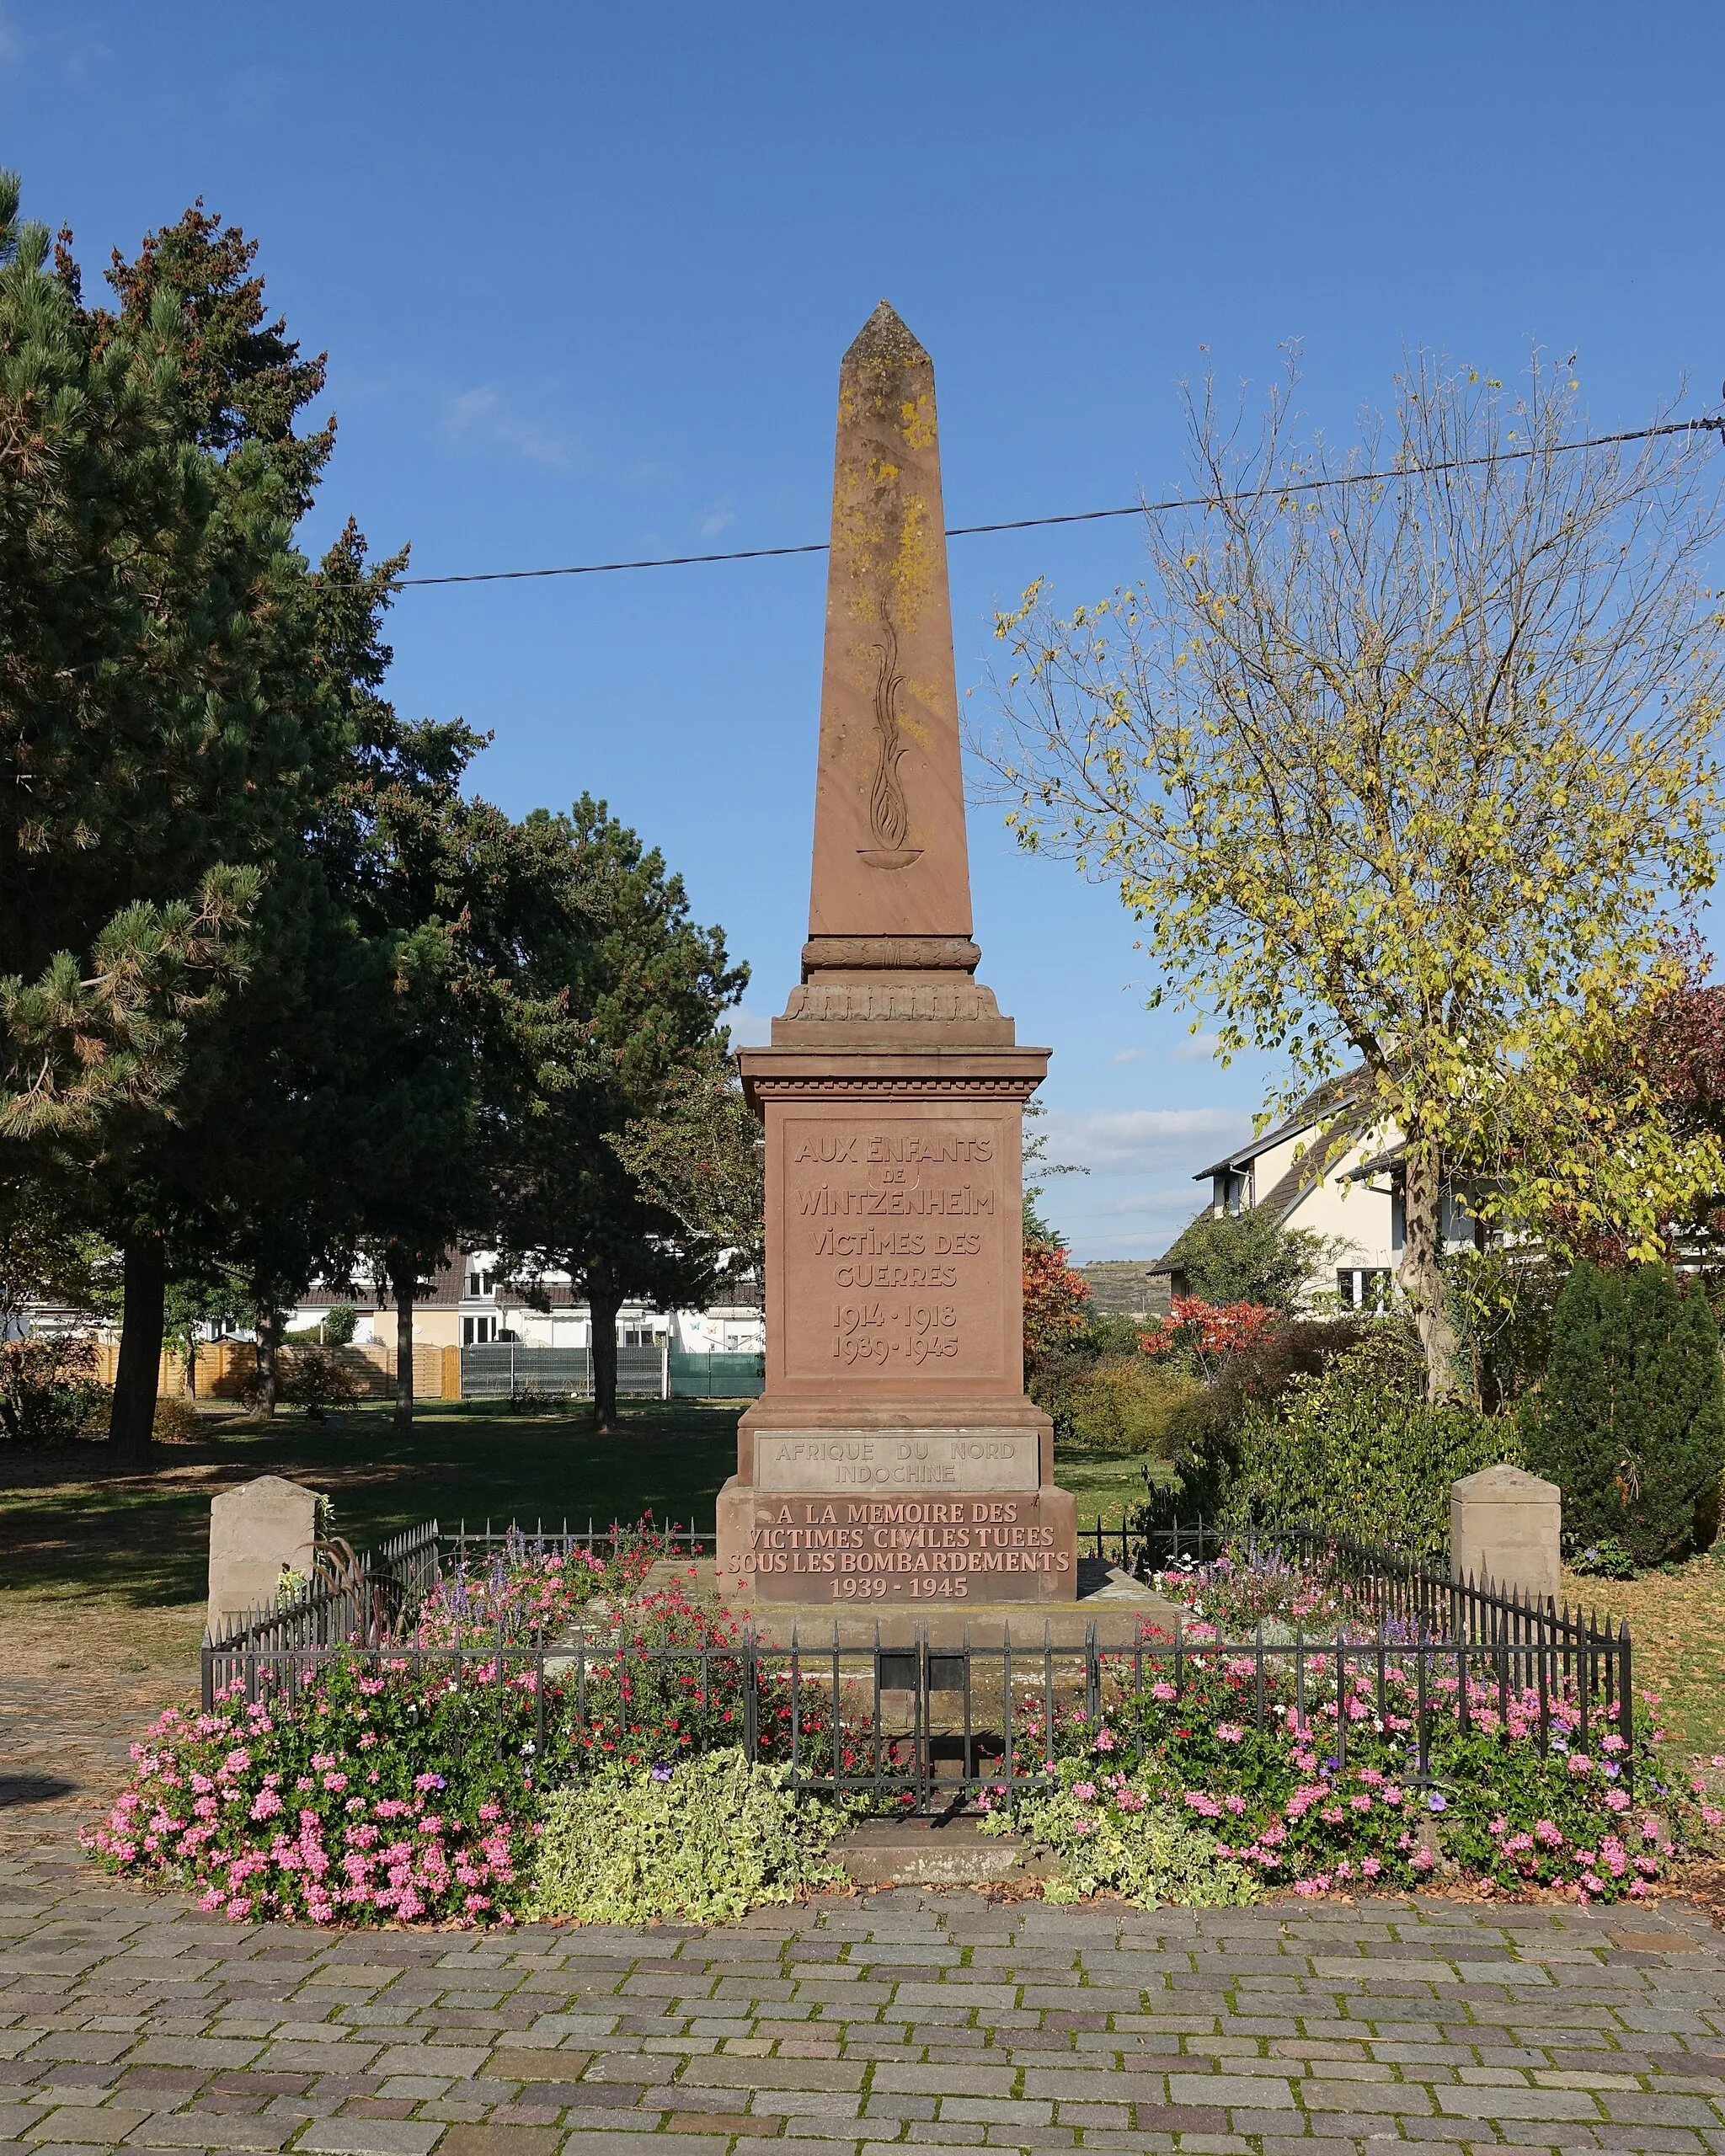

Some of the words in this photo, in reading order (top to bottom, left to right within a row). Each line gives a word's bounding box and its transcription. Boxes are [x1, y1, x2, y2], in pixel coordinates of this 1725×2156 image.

[795, 1137, 857, 1162] AUX
[866, 1136, 993, 1162] ENFANTS
[883, 1168, 906, 1183] DE
[795, 1182, 995, 1215] WINTZENHEIM
[809, 1226, 926, 1255] VICTIMES
[934, 1231, 981, 1255] DES
[834, 1264, 957, 1288] GUERRES
[832, 1302, 884, 1336] 1914
[904, 1305, 957, 1336] 1918
[832, 1336, 889, 1366] 1939
[905, 1335, 959, 1366] 1945
[776, 1442, 874, 1462] AFRIQUE
[896, 1443, 928, 1460] DU
[950, 1442, 1016, 1460] NORD
[835, 1464, 956, 1483] INDOCHINE
[777, 1504, 795, 1525] A
[804, 1504, 839, 1525] LA
[847, 1503, 964, 1524] MEMOIRE
[970, 1502, 1018, 1524] DES
[748, 1528, 864, 1550] VICTIMES
[873, 1527, 970, 1550] CIVILES
[977, 1527, 1055, 1548] TUEES
[728, 1553, 789, 1574] SOUS
[793, 1553, 836, 1573] LES
[840, 1551, 1070, 1573] BOMBARDEMENTS
[830, 1577, 889, 1598] 1939
[909, 1577, 969, 1598] 1945
